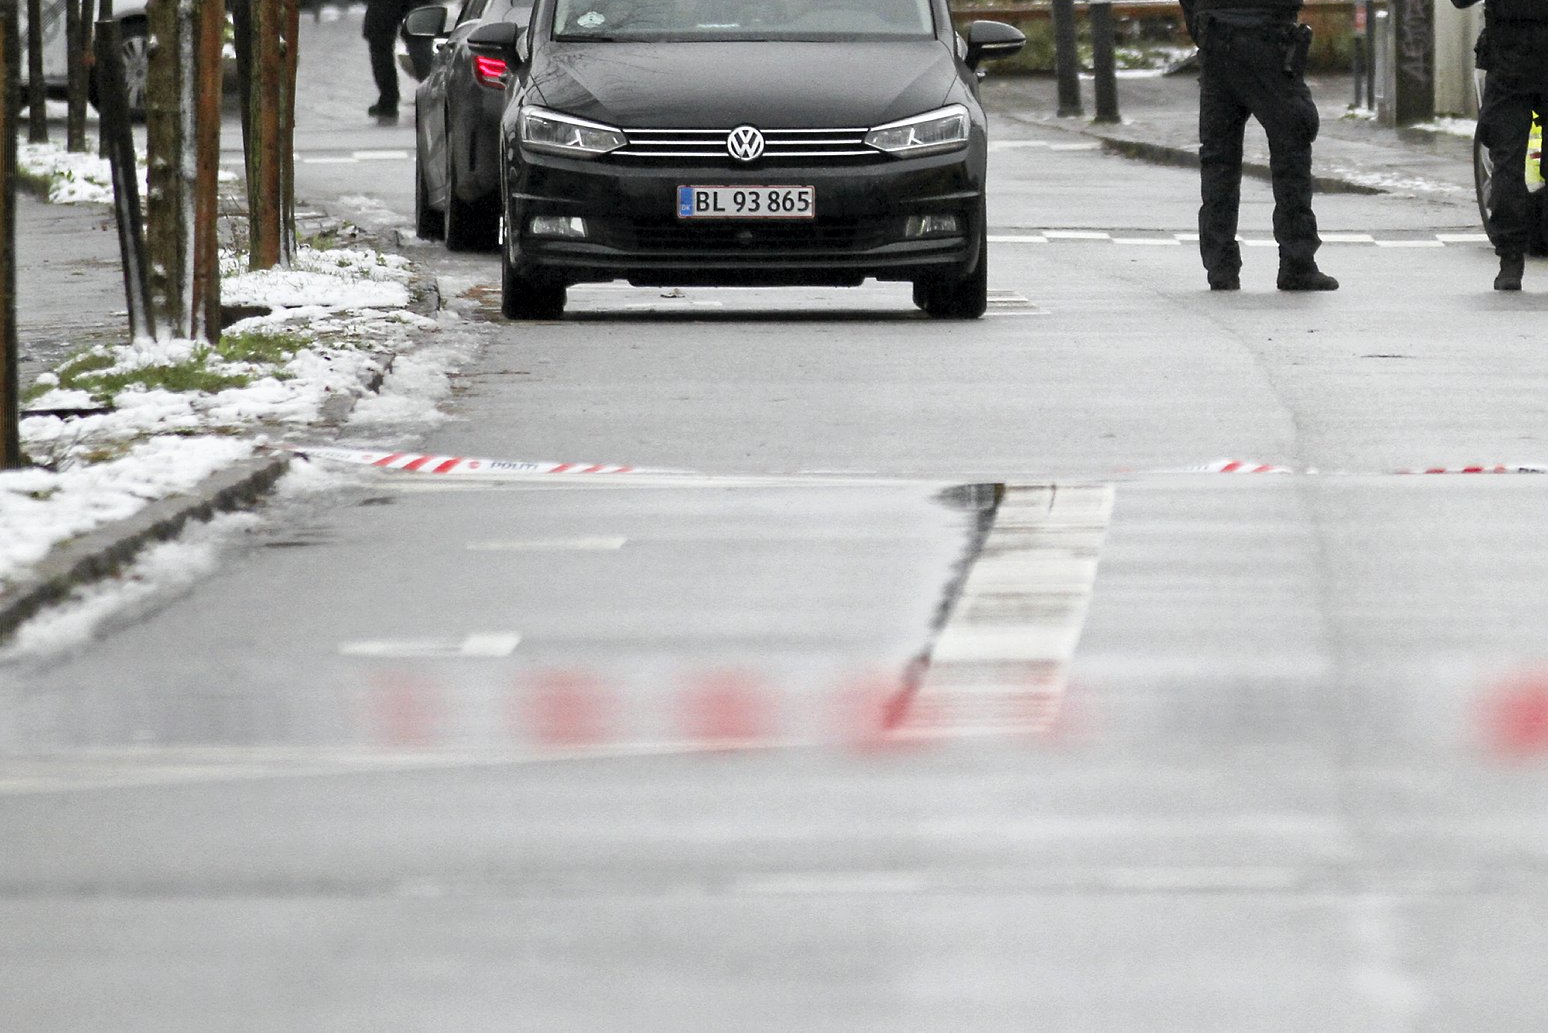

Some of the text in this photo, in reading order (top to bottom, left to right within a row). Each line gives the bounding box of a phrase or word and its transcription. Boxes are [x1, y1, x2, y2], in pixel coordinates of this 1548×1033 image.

[696, 190, 810, 213] BL 93 865
